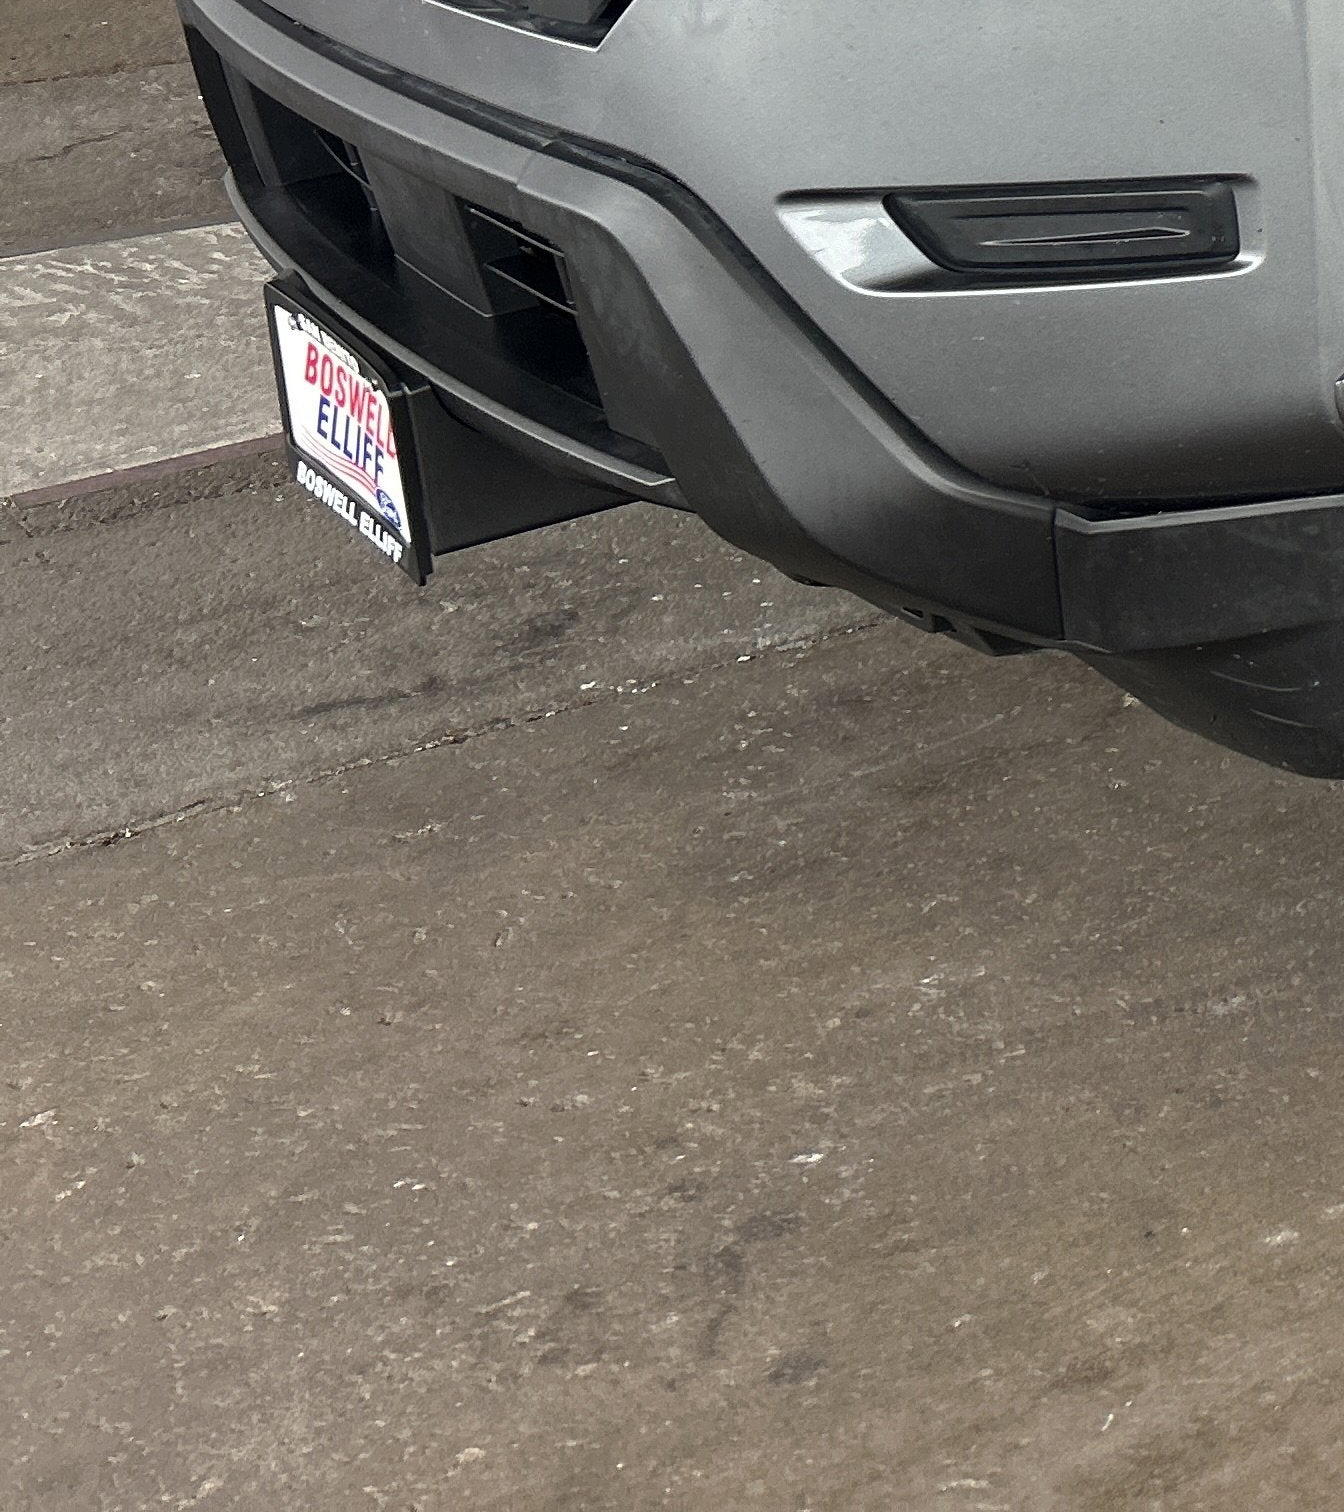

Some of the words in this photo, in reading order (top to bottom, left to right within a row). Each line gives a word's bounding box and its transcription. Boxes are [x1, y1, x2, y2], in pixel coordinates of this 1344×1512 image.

[304, 341, 397, 459] BOSWELL
[316, 394, 384, 485] ELLIFF
[296, 460, 358, 527] BOSWELL
[359, 511, 403, 563] ELLIFF
